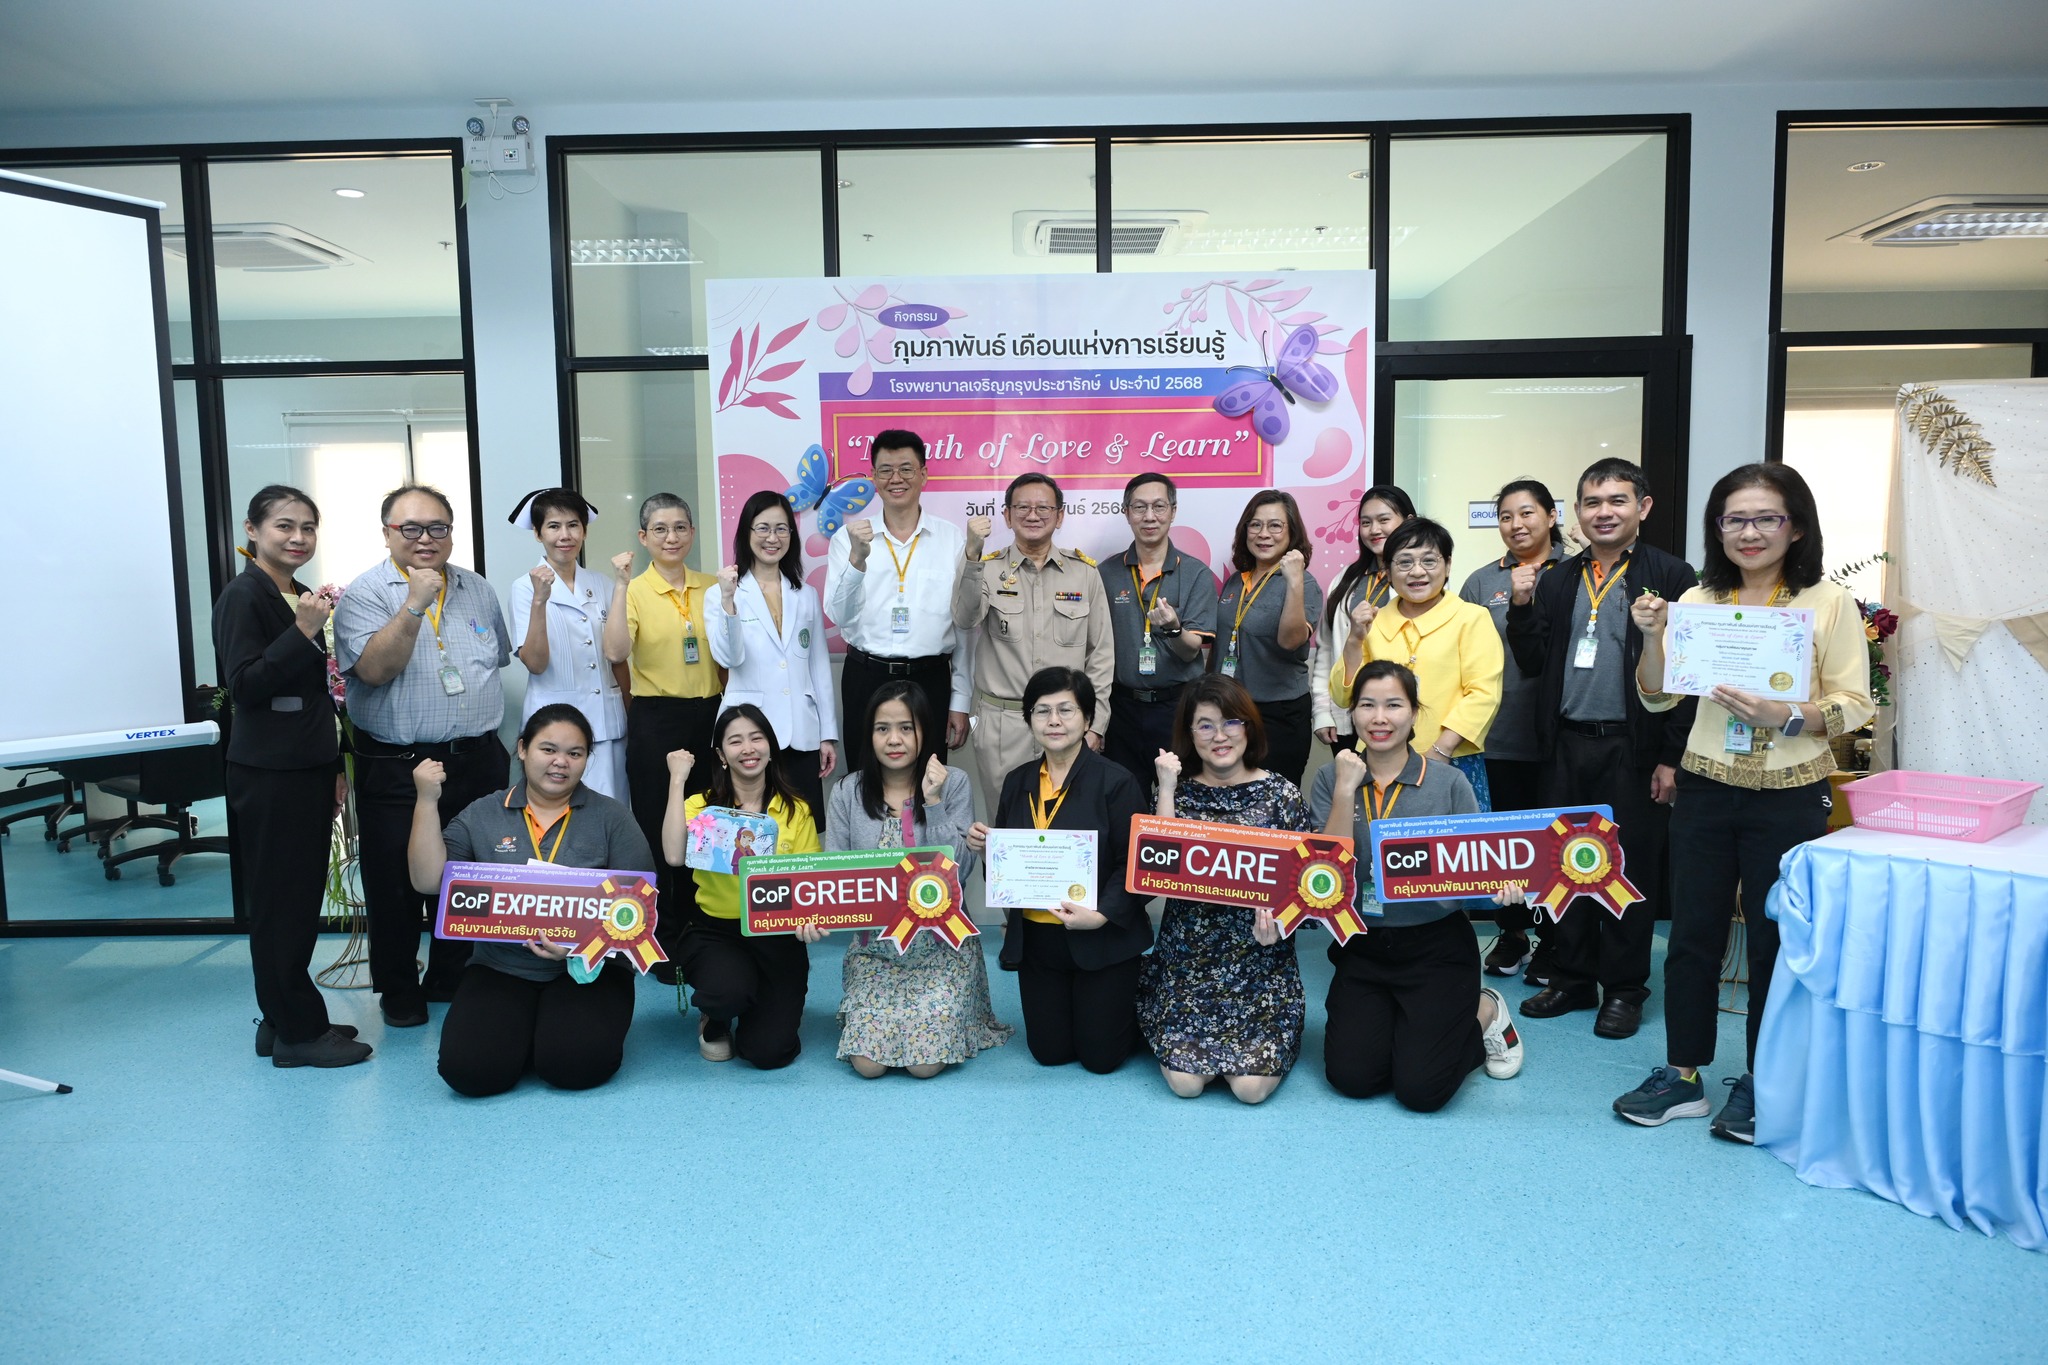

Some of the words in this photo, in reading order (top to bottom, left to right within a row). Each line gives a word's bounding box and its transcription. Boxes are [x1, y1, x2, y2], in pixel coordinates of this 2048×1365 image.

[894, 311, 938, 322] กิจกรรม
[893, 333, 1007, 364] กุมภาพันธ์
[1012, 329, 1227, 361] เดือนแห่งการเรียนรู้
[889, 374, 1101, 395] โรงพยาบาลเจริญกรุงประชารักษ์
[1109, 375, 1161, 390] ประจำปี
[1165, 376, 1203, 390] 2568
[978, 432, 1013, 468] of
[1019, 433, 1092, 464] Love
[1105, 433, 1129, 465] &
[966, 497, 995, 516] วันที่
[125, 729, 176, 739] VERTEX
[1403, 829, 1410, 837] of
[1140, 846, 1179, 866] CoP
[1185, 845, 1279, 885] CARE
[1386, 850, 1428, 870] CoP
[1436, 837, 1536, 874] MIND
[768, 865, 775, 874] of
[752, 885, 790, 904] CoP
[794, 876, 898, 906] GREEN
[1141, 873, 1270, 902] ฝ่ายวิชาการและแผนงาน
[451, 891, 490, 910] CoP
[492, 892, 613, 921] EXPERTISE
[754, 912, 873, 930] กลุ่มงานอาชีวเวชกรรม
